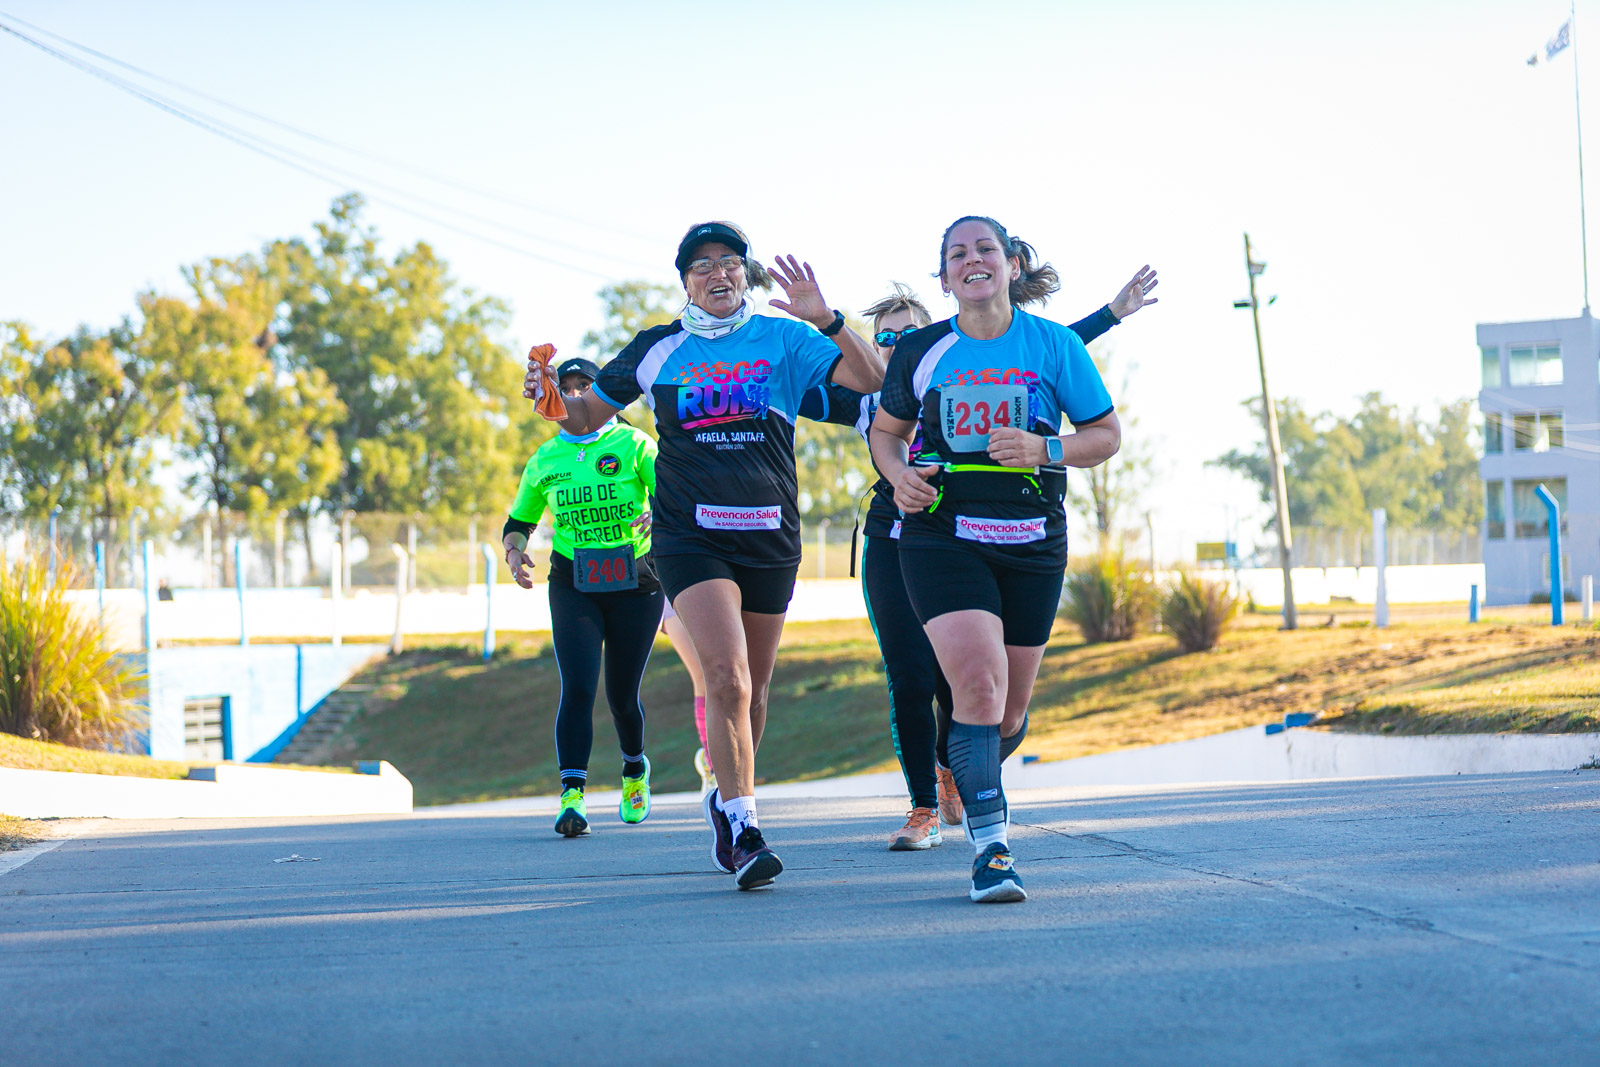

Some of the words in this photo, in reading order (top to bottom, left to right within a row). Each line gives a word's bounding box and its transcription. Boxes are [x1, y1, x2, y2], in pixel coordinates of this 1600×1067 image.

[712, 359, 770, 384] 500
[743, 367, 773, 376] MILLAS
[677, 384, 758, 420] RUN
[1014, 396, 1022, 428] EXACT
[946, 398, 954, 439] TIEMPO
[955, 400, 1011, 436] 234
[556, 485, 592, 507] CLUB
[597, 482, 617, 502] DE
[701, 507, 755, 520] Prevención
[755, 508, 778, 519] Salud
[960, 519, 1018, 533] Prevención
[1019, 520, 1042, 532] Salud
[587, 557, 627, 583] 240
